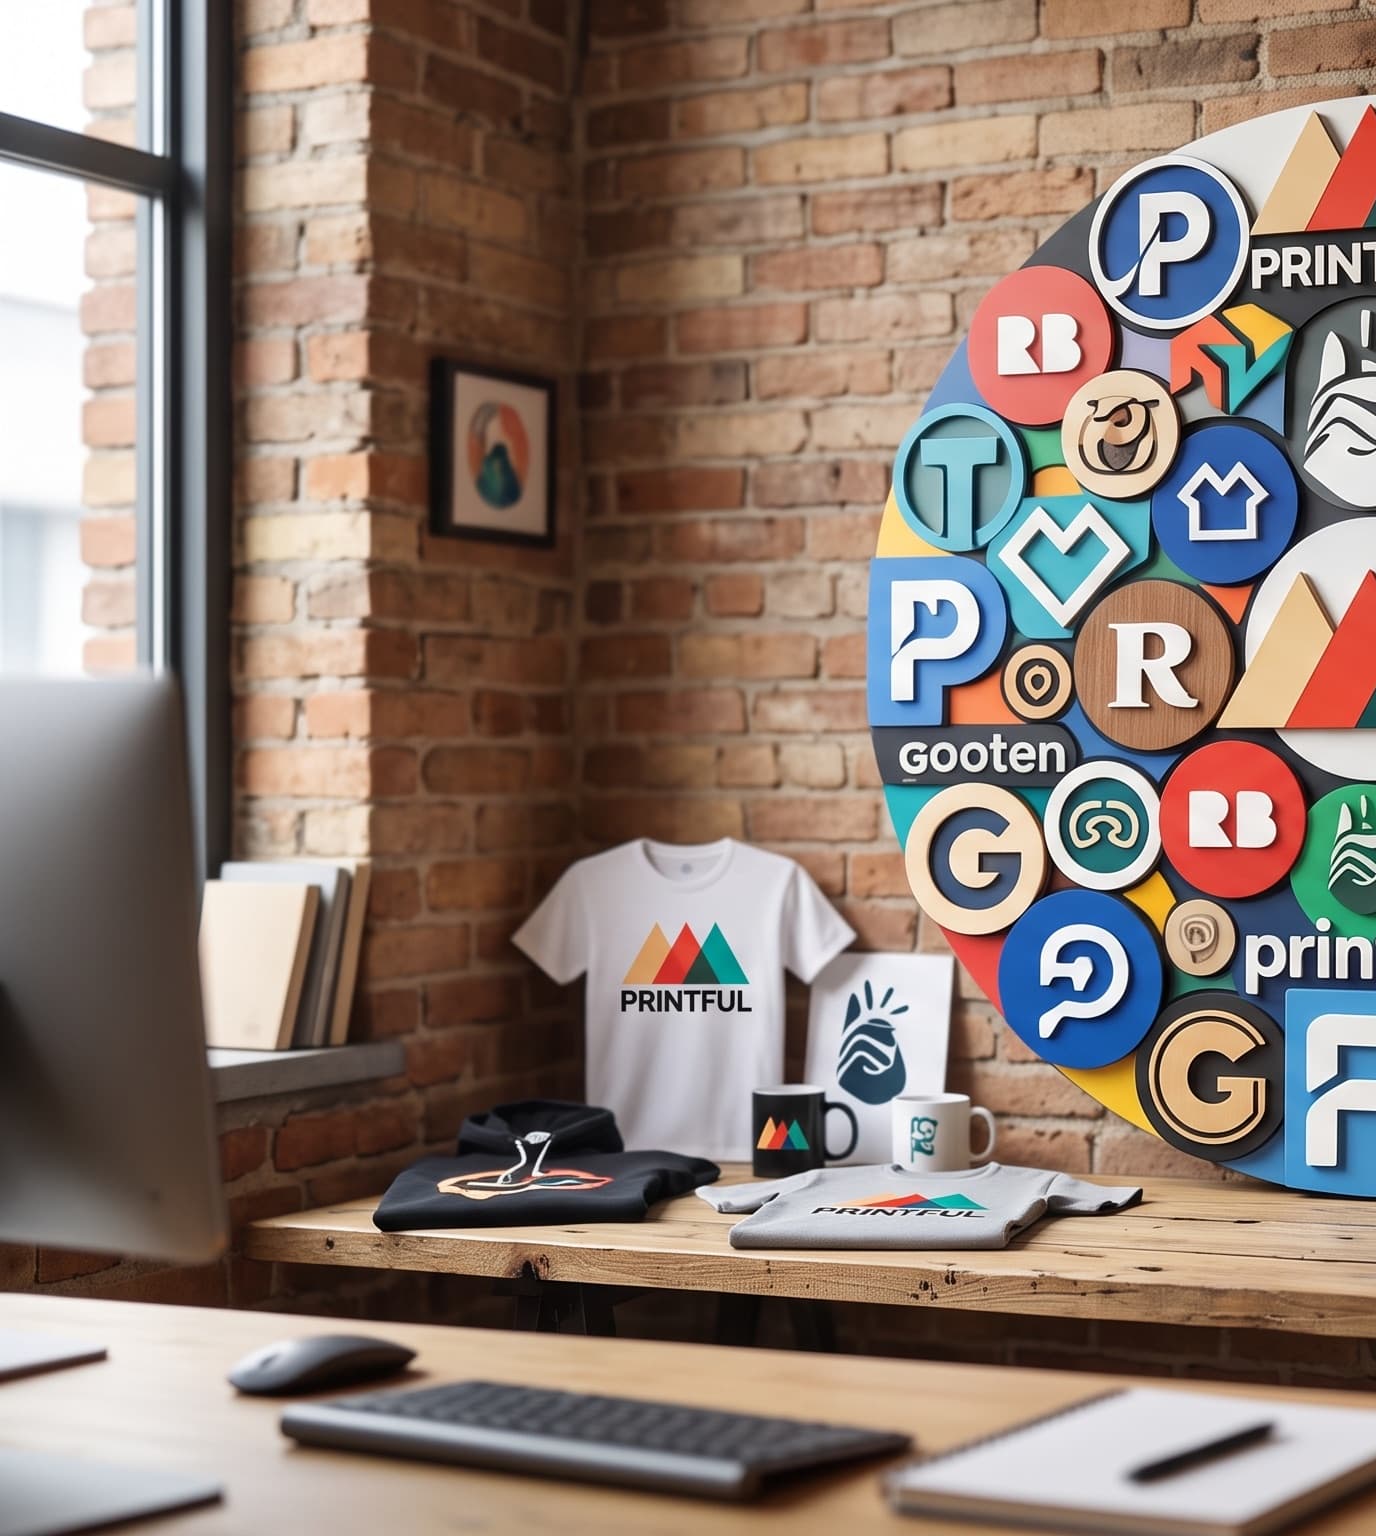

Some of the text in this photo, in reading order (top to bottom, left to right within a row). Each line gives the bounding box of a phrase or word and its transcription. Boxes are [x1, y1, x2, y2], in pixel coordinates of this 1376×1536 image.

[998, 312, 1082, 375] RB
[920, 436, 998, 549] T
[891, 579, 981, 702] P
[1107, 622, 1199, 709] R
[928, 806, 1023, 911] G
[1188, 790, 1278, 849] RB
[620, 989, 752, 1013] PRINTFUL
[1148, 1009, 1267, 1145] G
